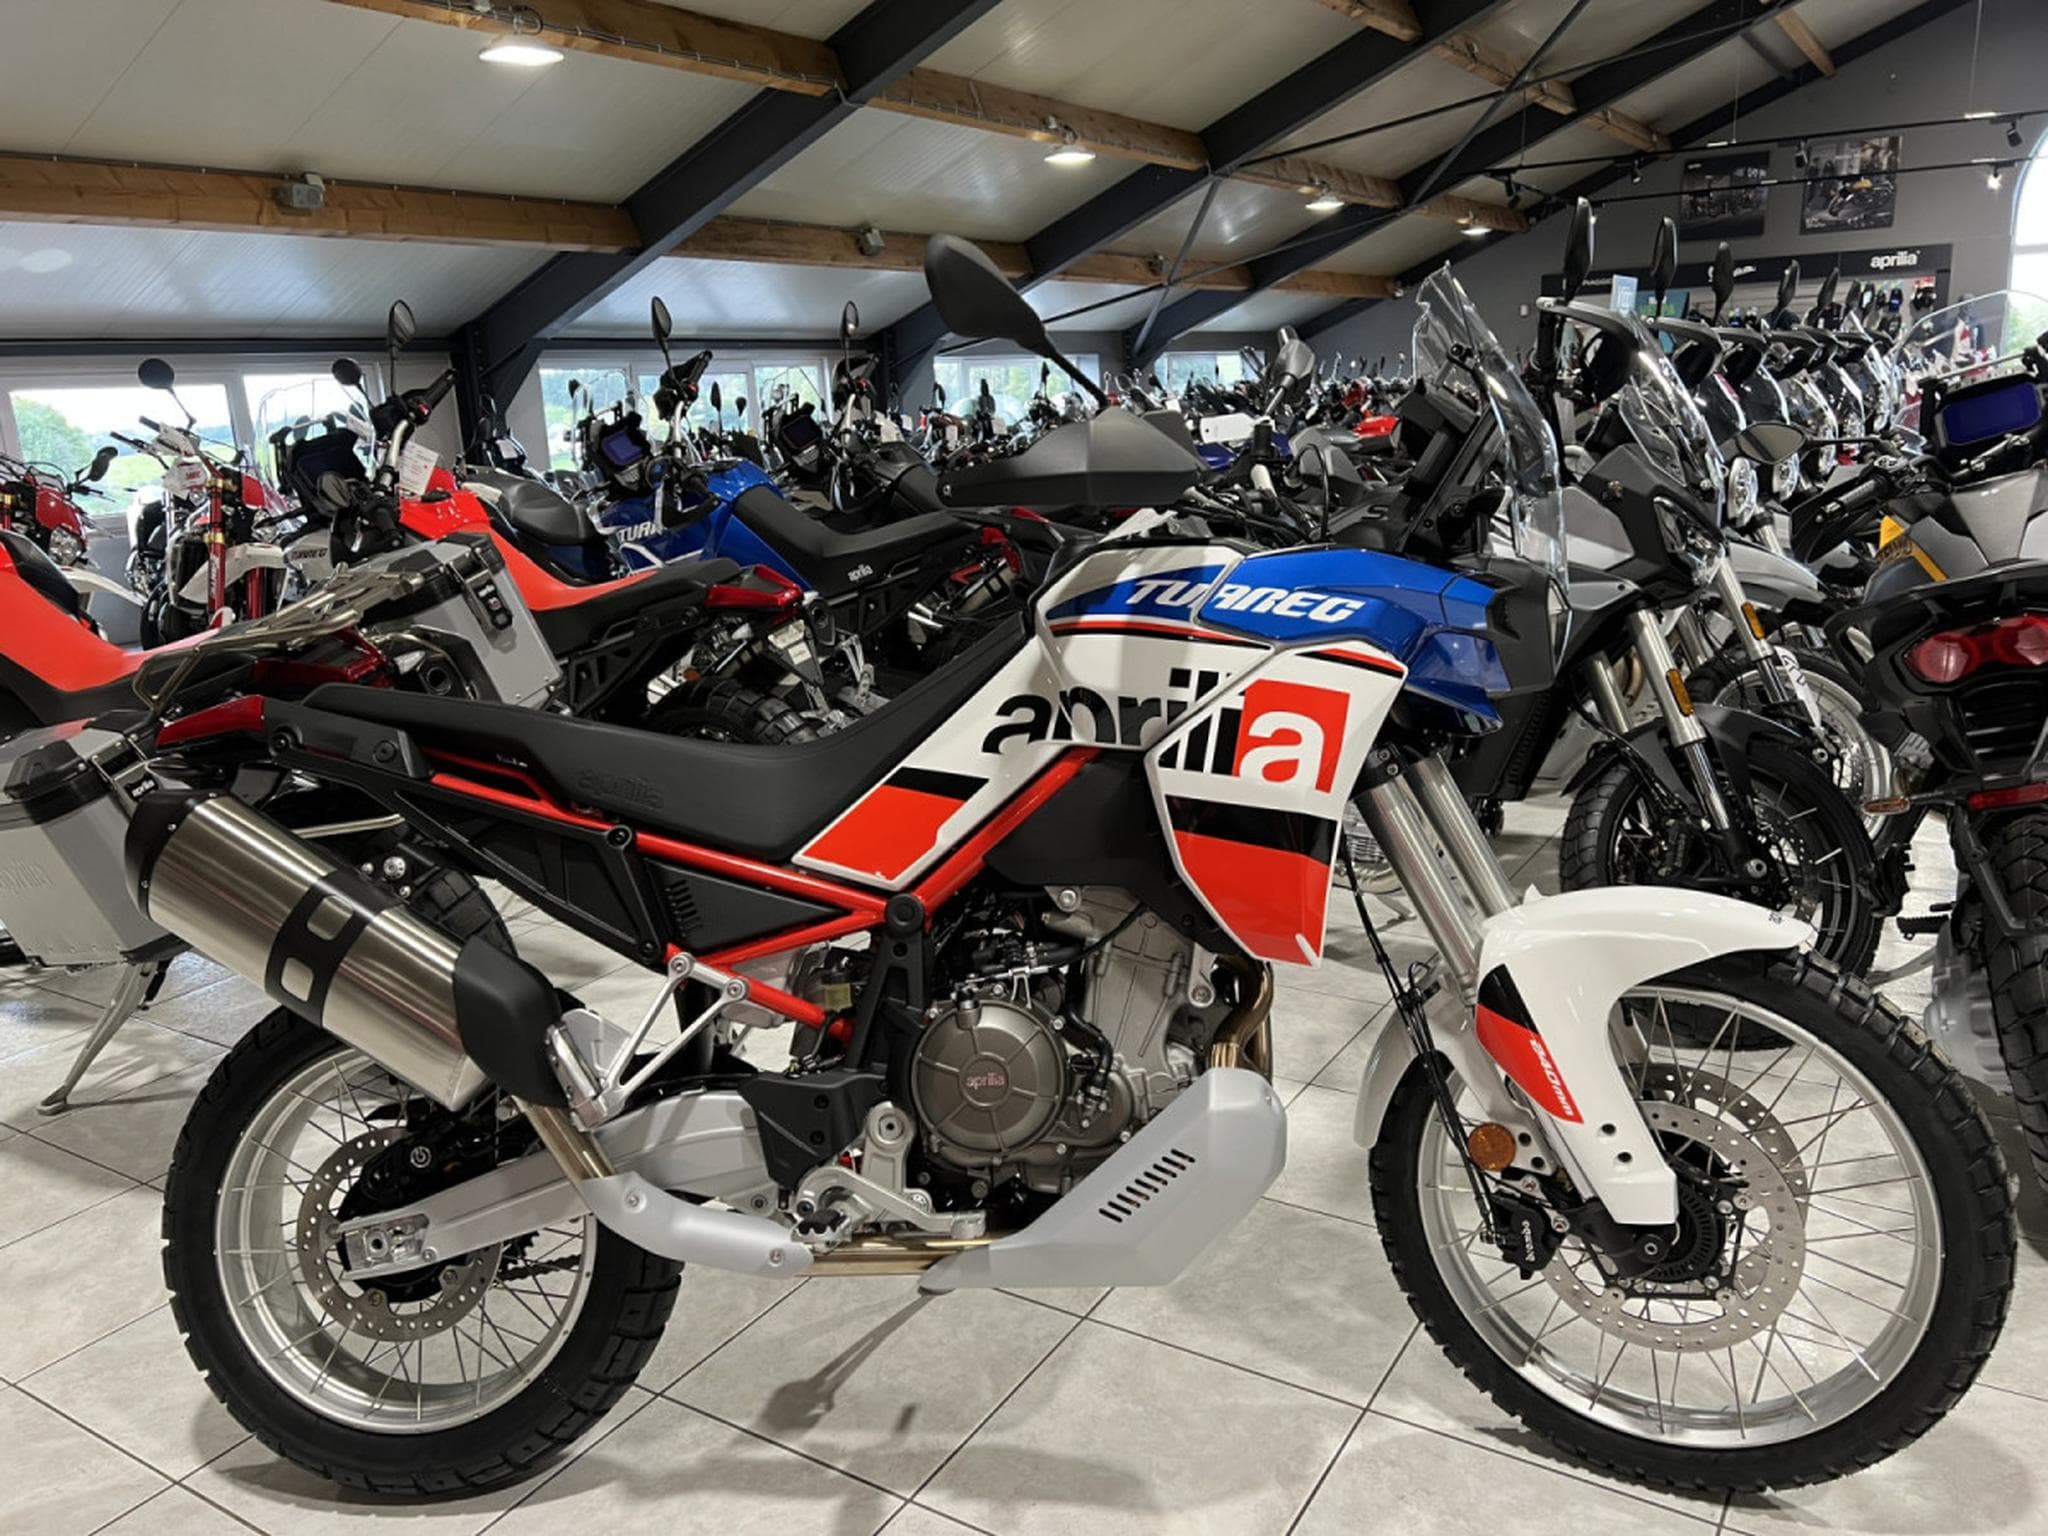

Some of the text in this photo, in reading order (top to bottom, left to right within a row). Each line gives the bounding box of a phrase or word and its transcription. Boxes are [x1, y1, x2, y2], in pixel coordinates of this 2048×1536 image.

[1870, 251, 1919, 270] aprilia
[1126, 579, 1366, 623] TUAREG
[981, 666, 1338, 791] aprilia
[967, 1072, 1005, 1090] aprilia
